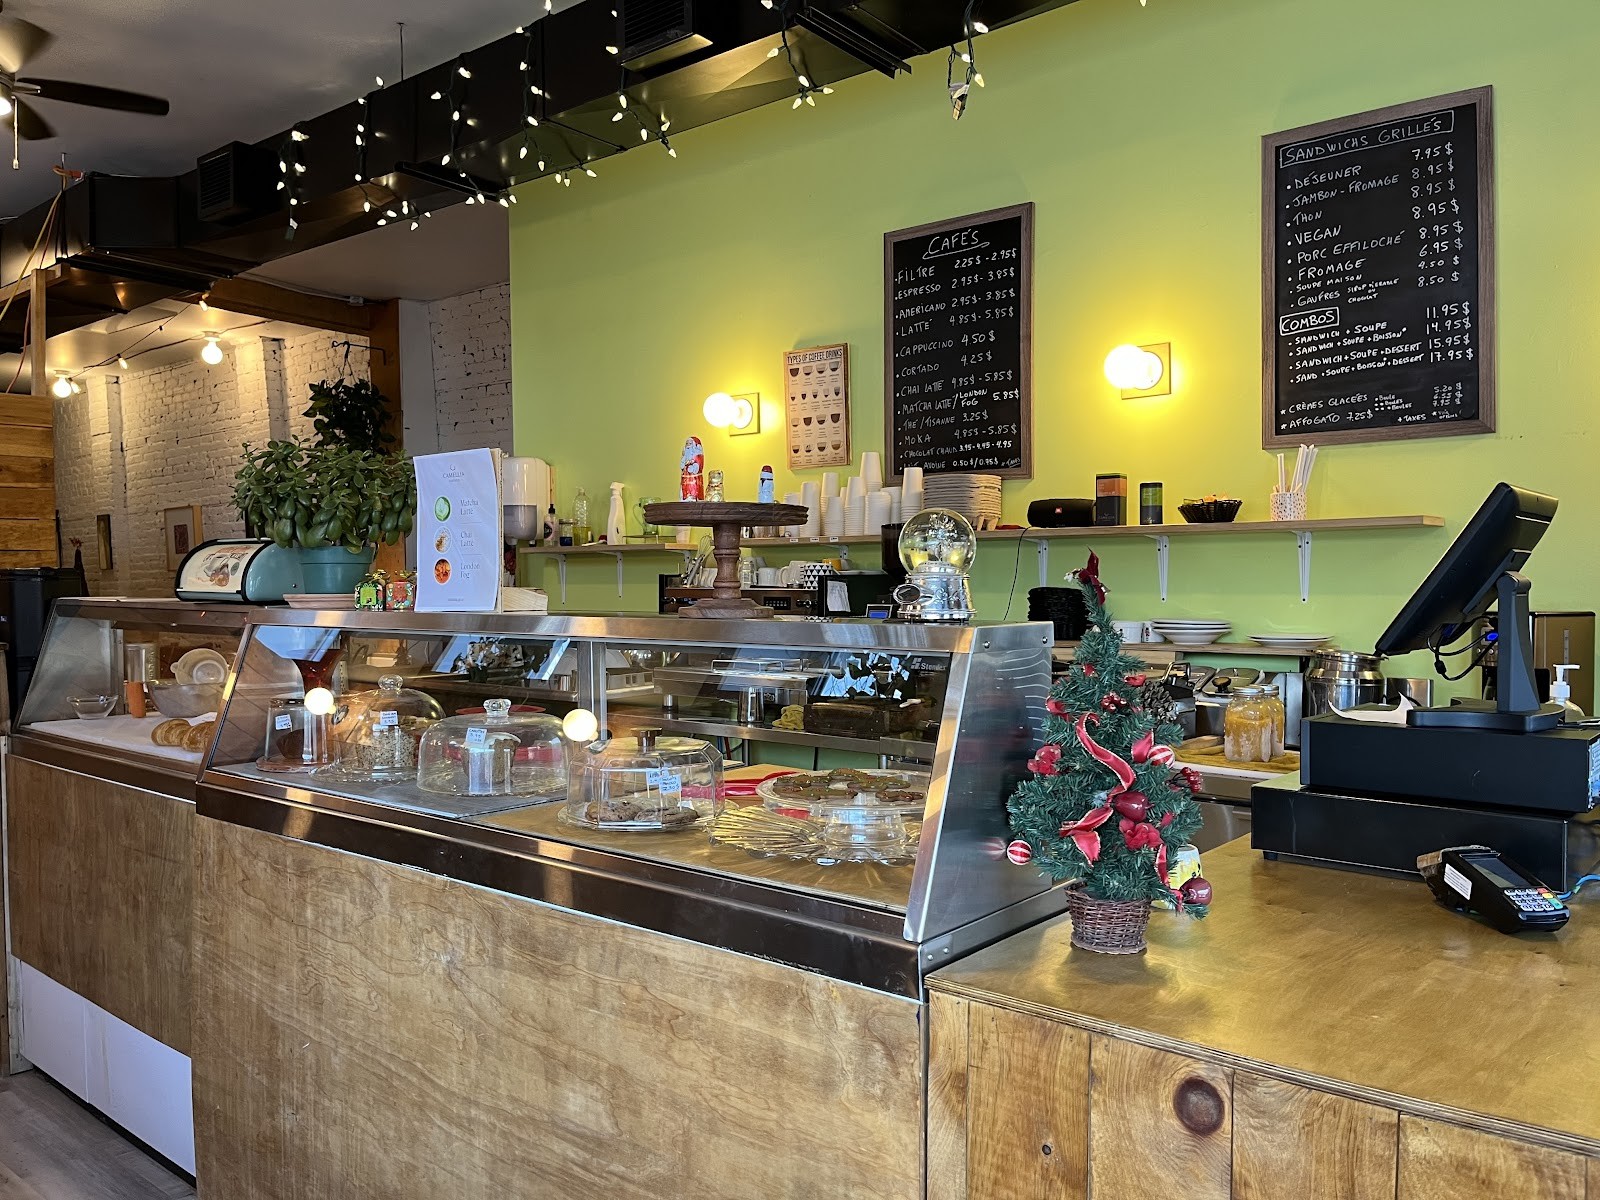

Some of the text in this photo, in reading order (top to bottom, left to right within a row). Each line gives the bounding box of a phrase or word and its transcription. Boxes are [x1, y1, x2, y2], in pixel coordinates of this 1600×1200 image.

[1284, 136, 1368, 164] SANDWICHS
[1295, 166, 1362, 189] DÉJEUNER
[1293, 188, 1337, 206] JAMBON
[1348, 173, 1399, 193] FROMAGE
[1293, 211, 1322, 225] THON
[1295, 225, 1342, 245] VEGAN
[1298, 248, 1326, 264] PORC
[897, 266, 935, 284] FILTRE
[1298, 257, 1366, 282] FROMAGE
[898, 284, 941, 300] ESPRESSO
[1296, 281, 1323, 294] SOUPE
[1326, 272, 1363, 287] MAISON
[1297, 290, 1340, 308] GAUFRES
[900, 303, 945, 321] AMERICANO
[1281, 311, 1335, 331] COMBOS
[1294, 330, 1341, 346] SANDWICH
[1354, 322, 1388, 335] SOUPE
[900, 340, 953, 356] CAPPUCCINO
[1295, 341, 1333, 356] SANDWICH
[1343, 336, 1364, 346] SOUPE
[787, 354, 801, 363] TYPES
[809, 351, 825, 360] COFFEE
[826, 348, 842, 358] DRINKS
[1296, 354, 1343, 371] SANDWICH
[1350, 349, 1378, 360] SOUPE
[1385, 342, 1423, 356] DESSERT
[1326, 366, 1352, 376] SOUPE
[1392, 352, 1424, 365] DESSERT
[902, 364, 939, 376] CORTADO
[901, 385, 919, 396] CHAI
[903, 401, 932, 417] MATCHA
[962, 398, 978, 407] FOG
[1289, 411, 1340, 428] AFFOGATO
[905, 434, 931, 445] MOKA
[904, 447, 934, 457] CHOCOLAT
[460, 562, 480, 570] London
